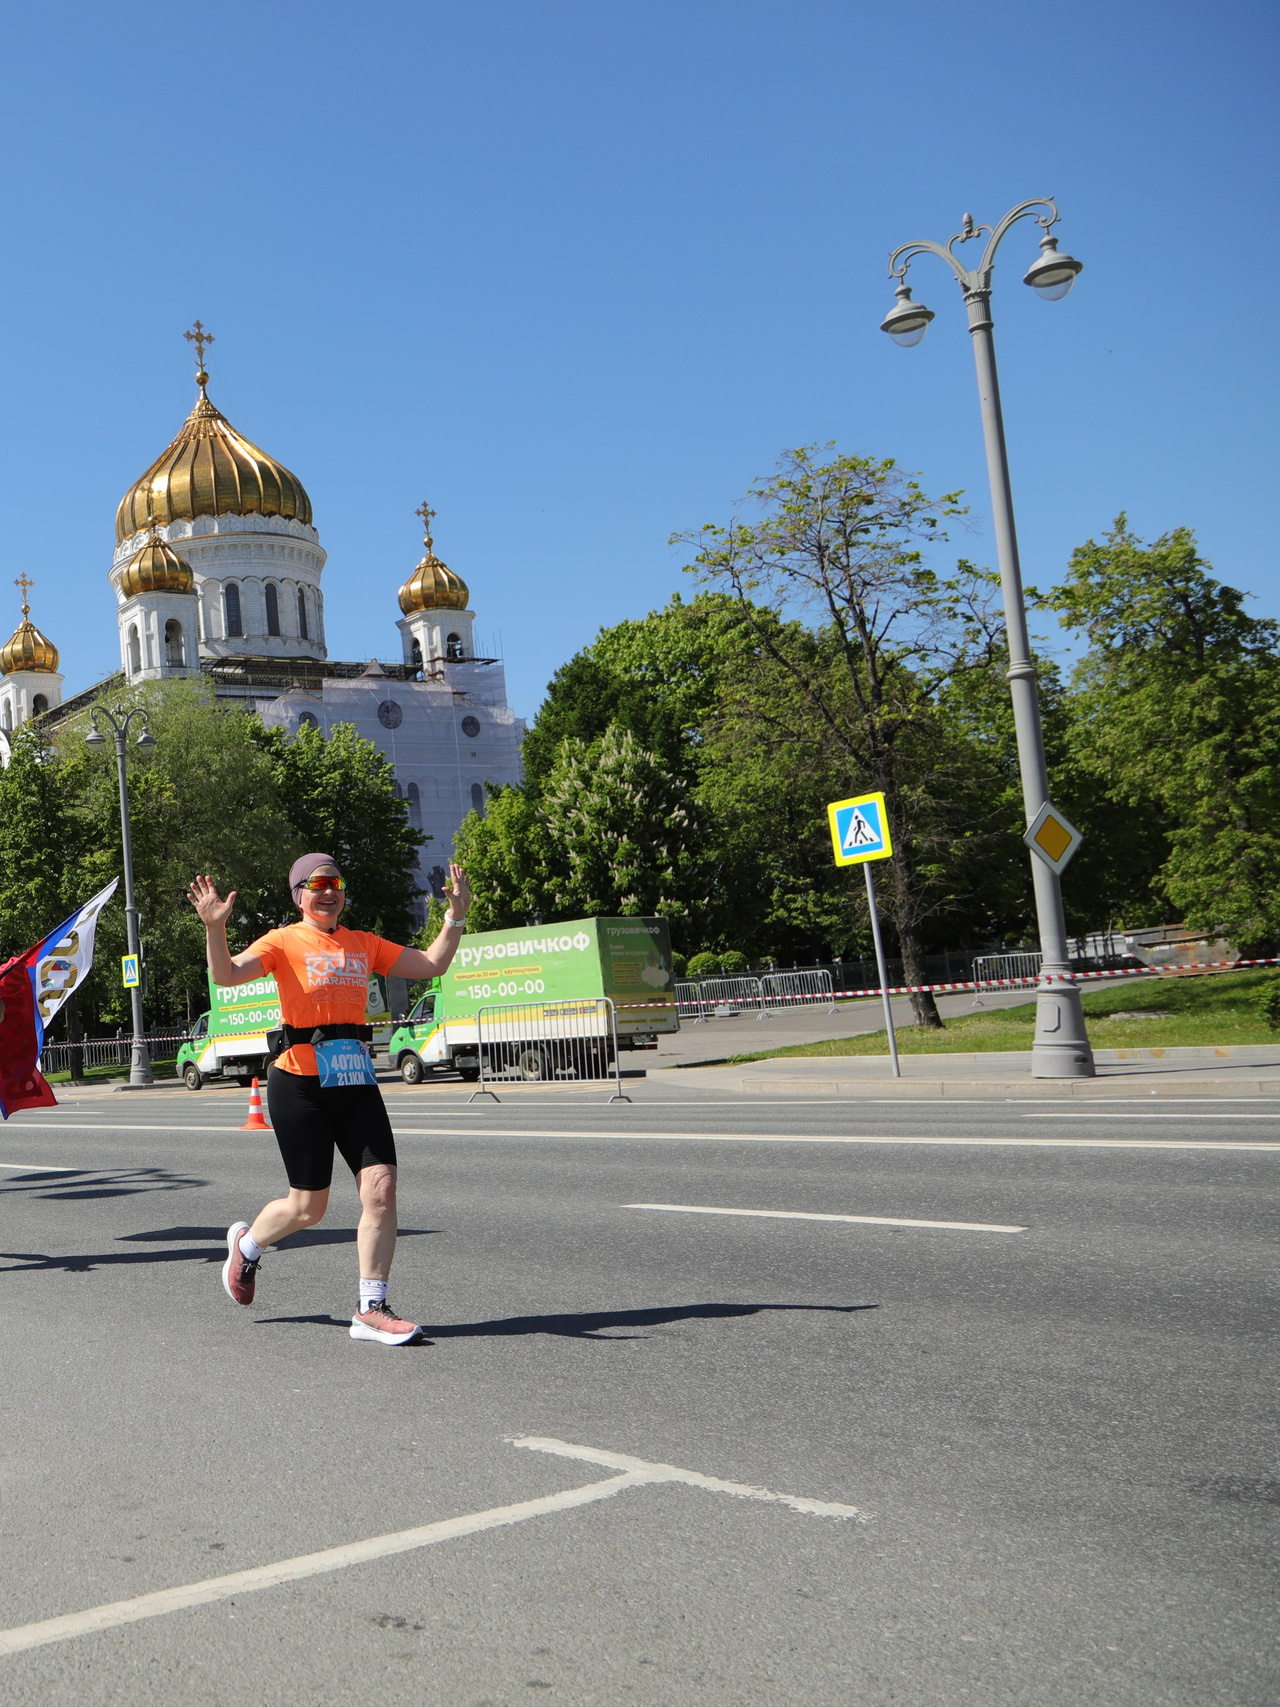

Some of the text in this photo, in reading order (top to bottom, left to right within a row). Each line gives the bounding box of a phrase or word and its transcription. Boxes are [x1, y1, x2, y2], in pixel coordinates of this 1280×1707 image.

[306, 957, 368, 978] KAZAN
[468, 979, 545, 999] 150-00-00
[228, 1008, 281, 1025] 150-00-00
[331, 1053, 366, 1071] 40701
[337, 1071, 366, 1086] 21.1KM
